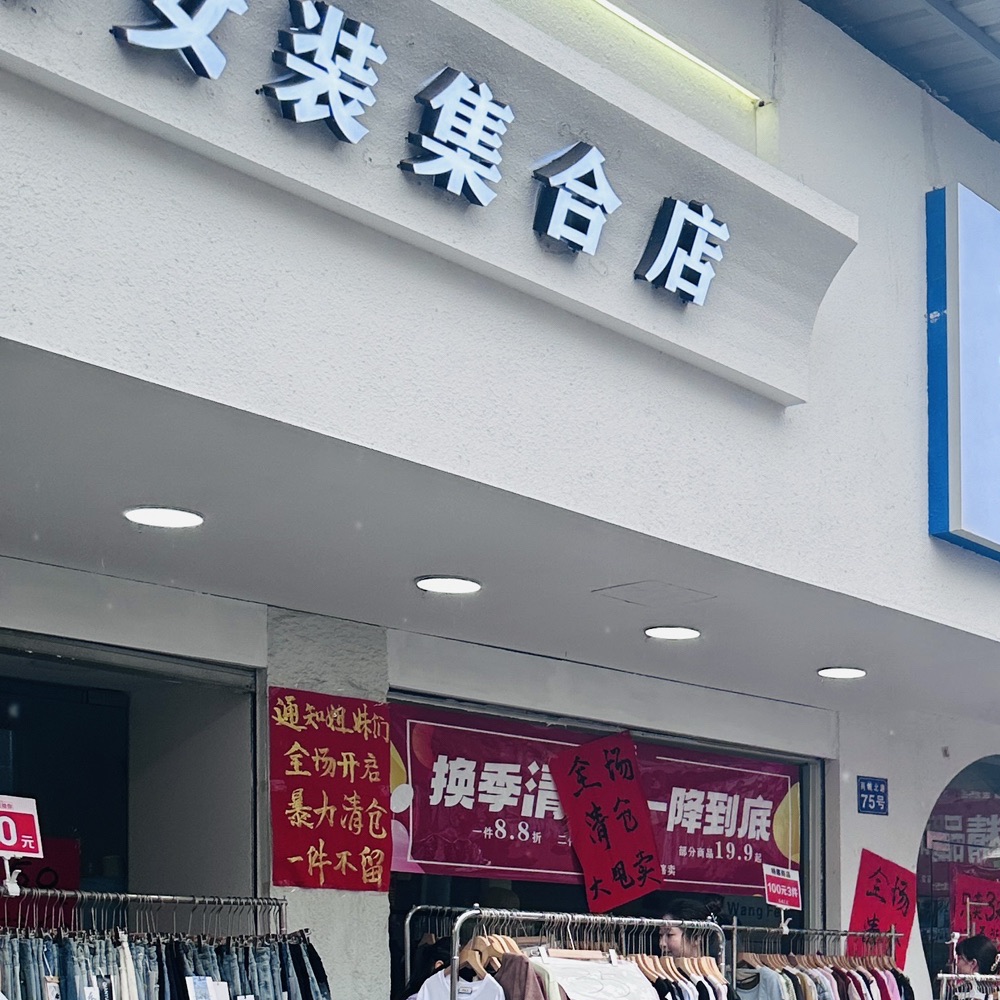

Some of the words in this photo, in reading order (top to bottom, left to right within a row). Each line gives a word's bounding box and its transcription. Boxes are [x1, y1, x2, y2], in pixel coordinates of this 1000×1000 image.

[271, 695, 390, 743] 通知姐妹们
[284, 741, 381, 783] 全场开启
[285, 788, 388, 839] 暴力清仓
[585, 797, 639, 850] 清仓
[860, 794, 886, 811] 75号
[472, 818, 542, 845] 一件8.8折
[678, 841, 763, 864] 部分商品19.9起
[286, 838, 385, 887] 一件不留
[589, 850, 662, 900] 大甩卖
[727, 901, 763, 919] Wang
[767, 882, 798, 898] 100元3件
